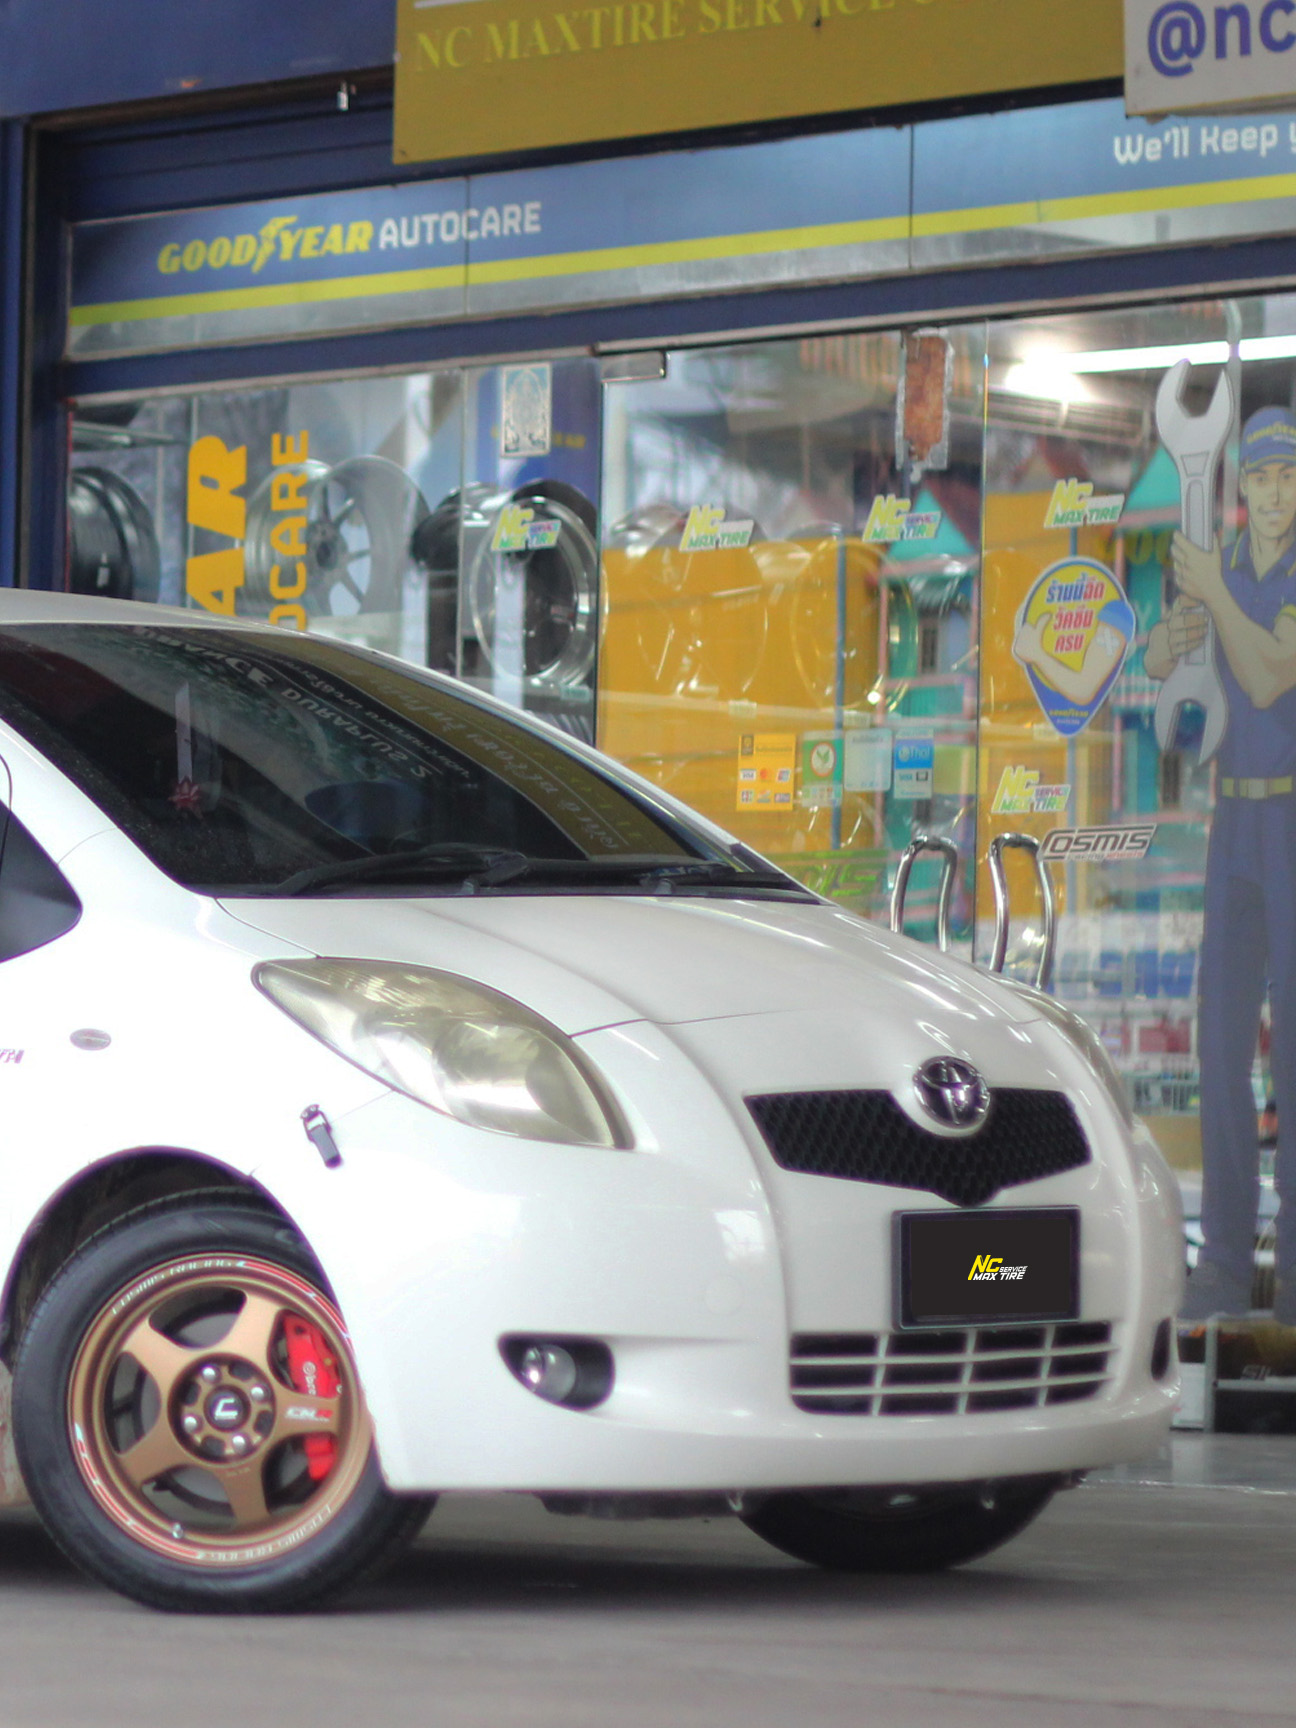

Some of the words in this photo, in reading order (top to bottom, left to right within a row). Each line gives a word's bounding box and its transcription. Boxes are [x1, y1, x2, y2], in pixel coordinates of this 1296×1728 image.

[415, 27, 472, 71] NC
[1113, 126, 1190, 165] We'll
[157, 215, 374, 274] GOODYEAR
[378, 202, 542, 251] AUTOCARE
[1040, 826, 1155, 860] COSMIS
